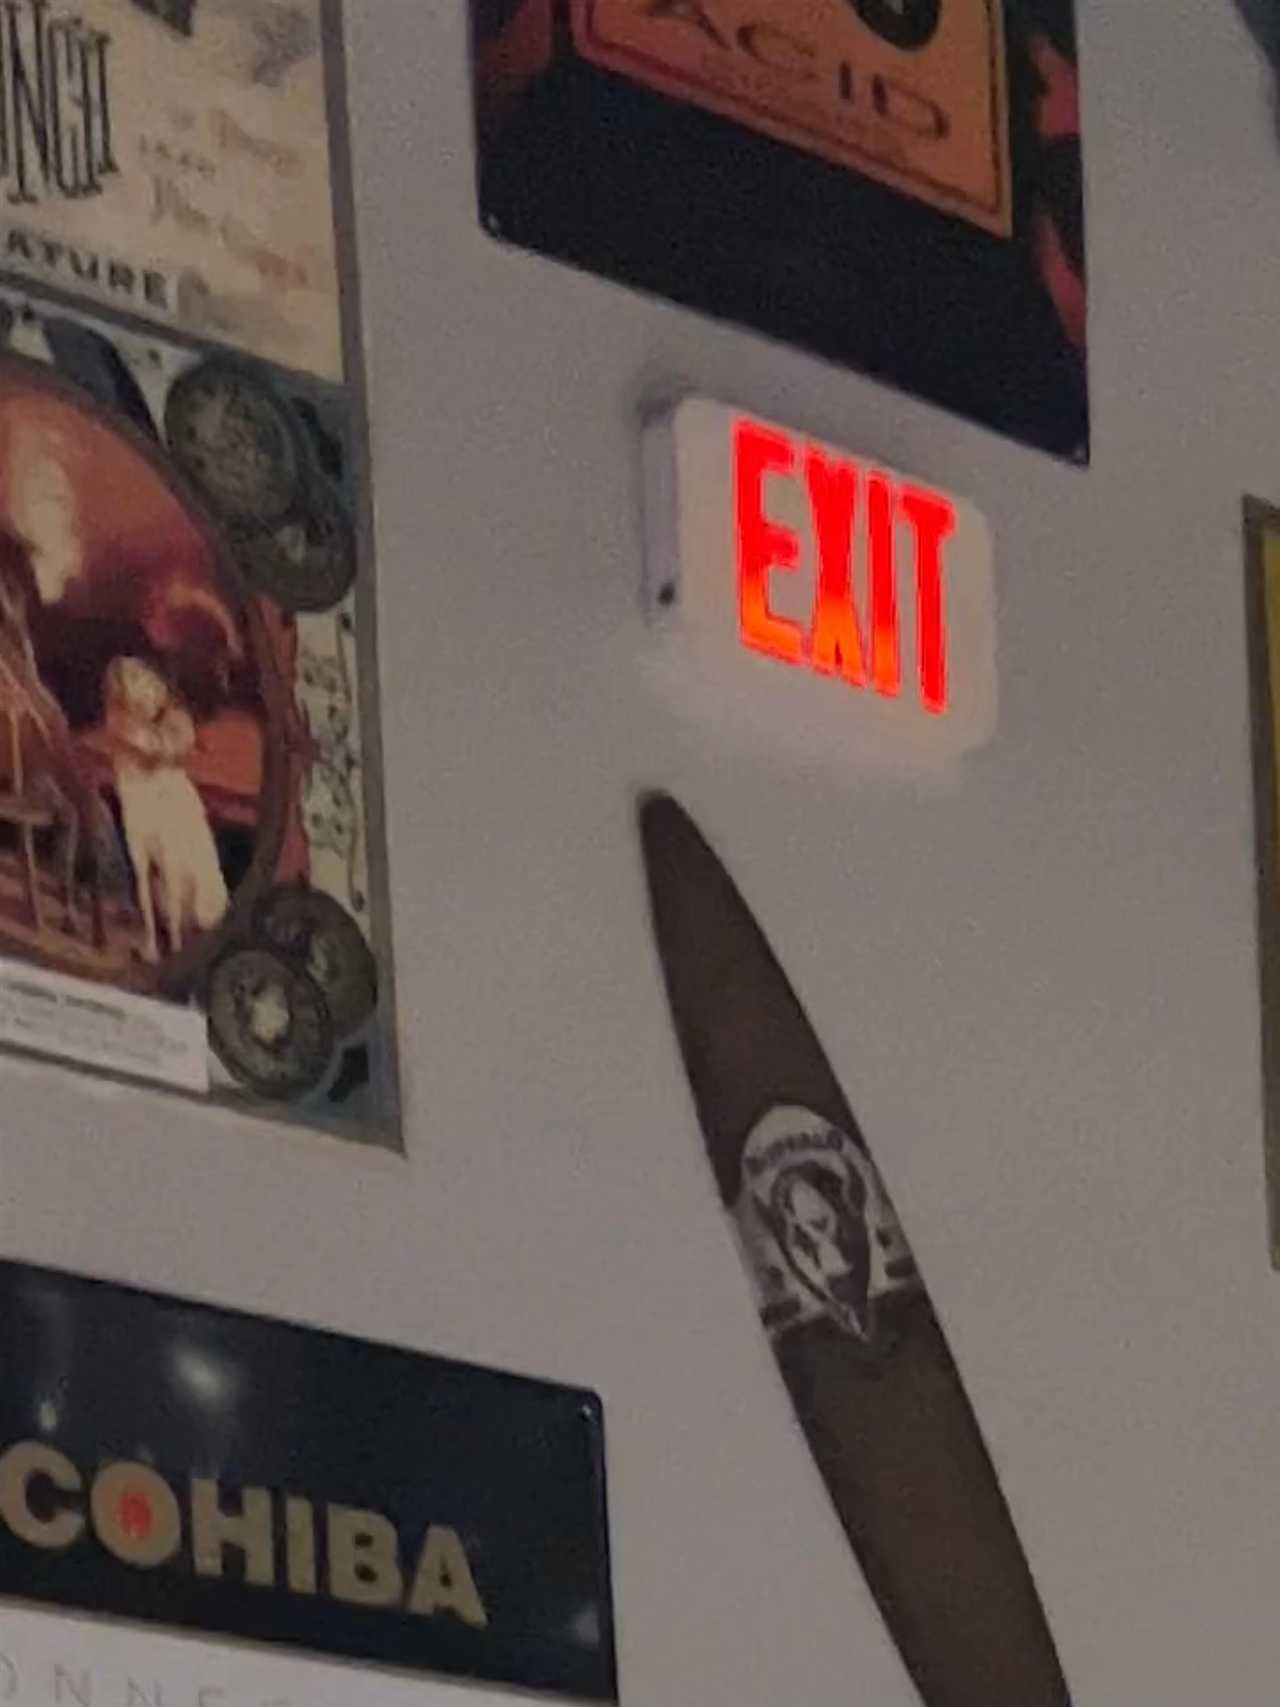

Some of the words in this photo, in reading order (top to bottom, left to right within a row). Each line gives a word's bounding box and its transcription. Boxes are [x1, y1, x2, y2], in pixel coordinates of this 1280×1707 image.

[0, 0, 118, 206] NCH
[732, 412, 956, 715] EXIT
[0, 1440, 489, 1628] COHIBA
